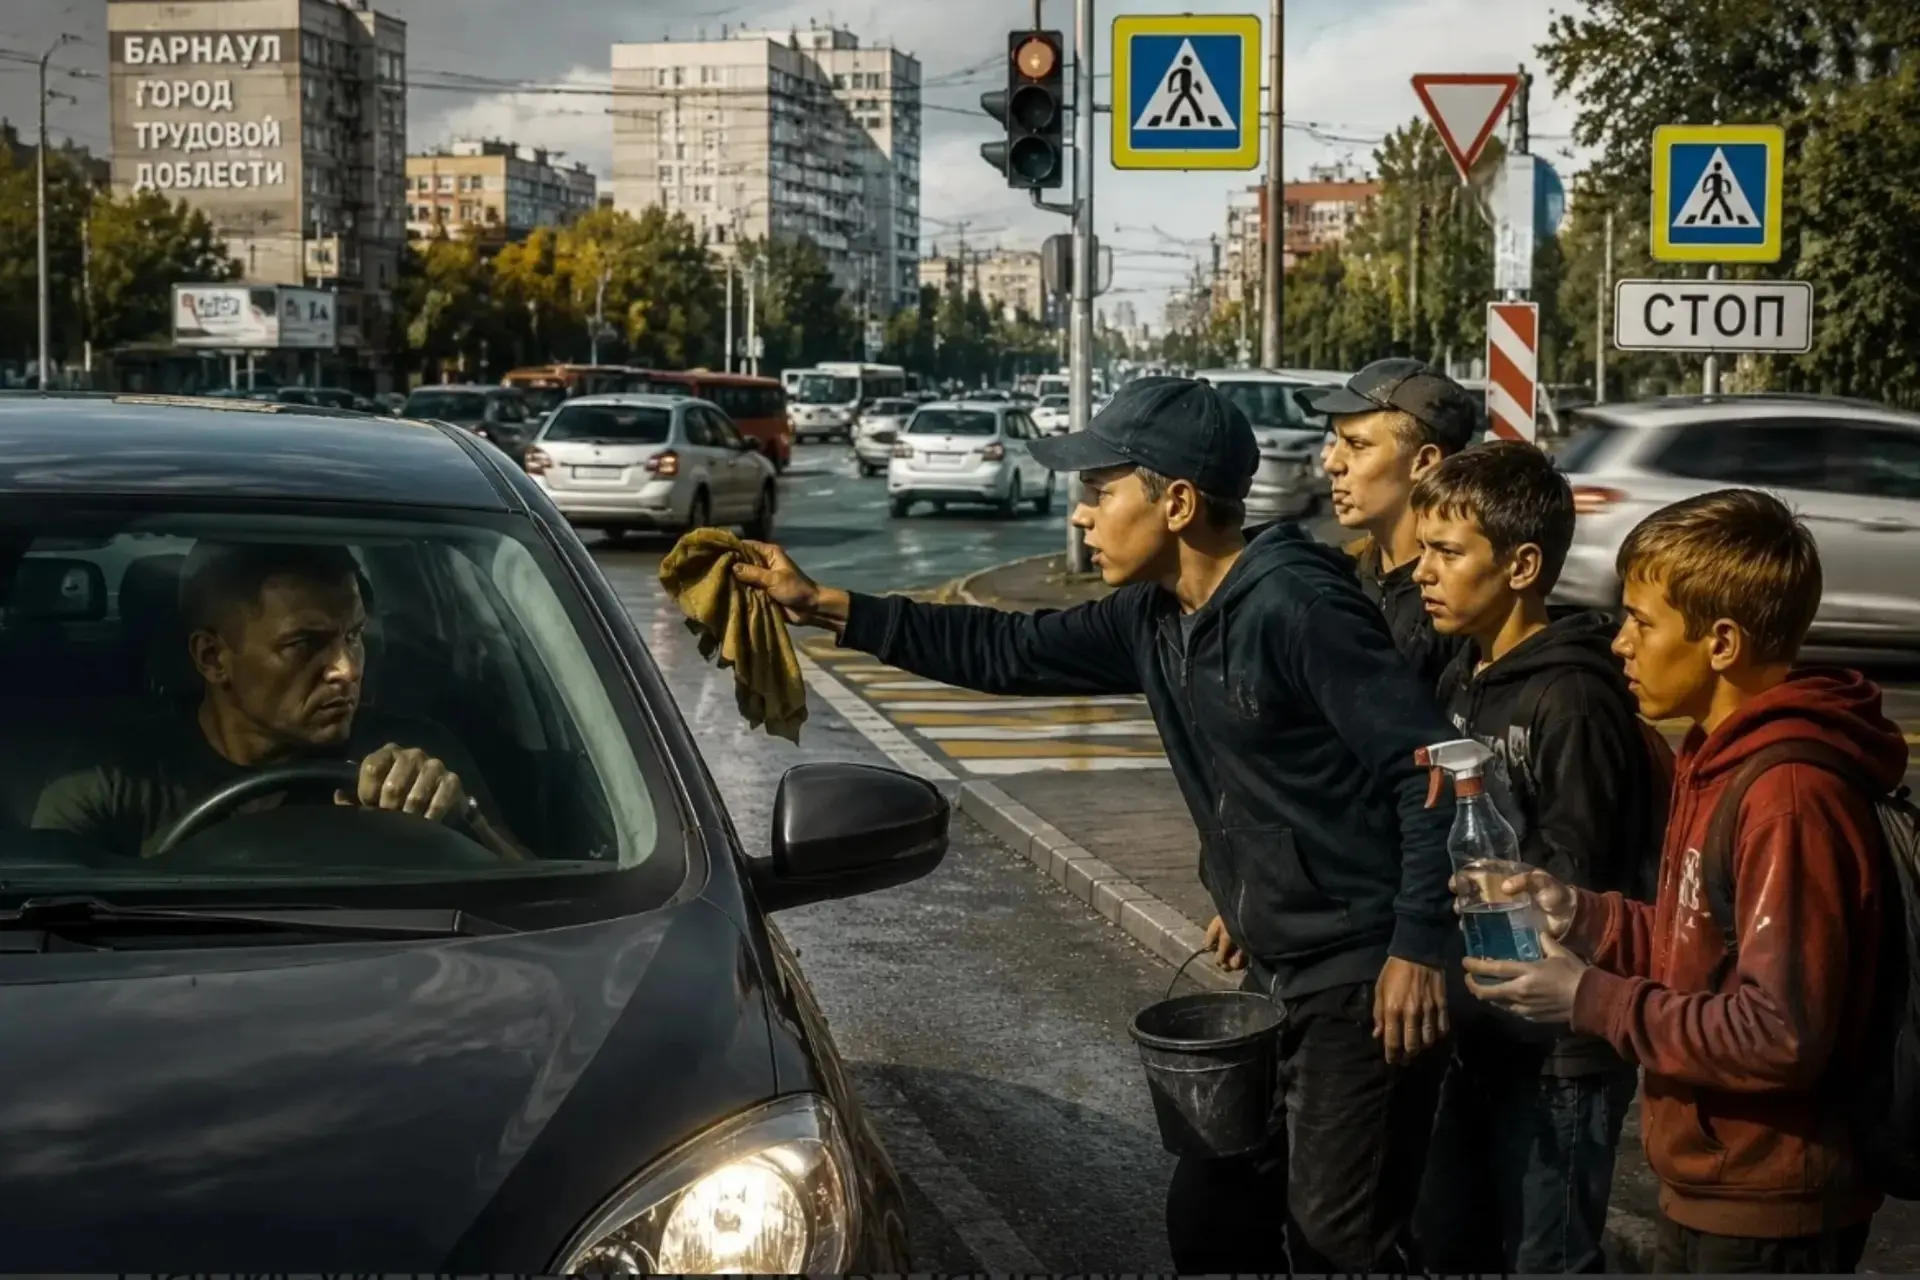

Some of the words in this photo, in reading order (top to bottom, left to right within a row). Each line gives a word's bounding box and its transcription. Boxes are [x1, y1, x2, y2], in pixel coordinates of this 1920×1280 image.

[124, 34, 281, 68] БАРНАУЛ
[135, 79, 234, 112] ГОРОД
[132, 114, 281, 154] ТРУДОВОЙ
[133, 160, 285, 192] ДОБЛЕСТИ
[1643, 293, 1785, 337] СТОП
